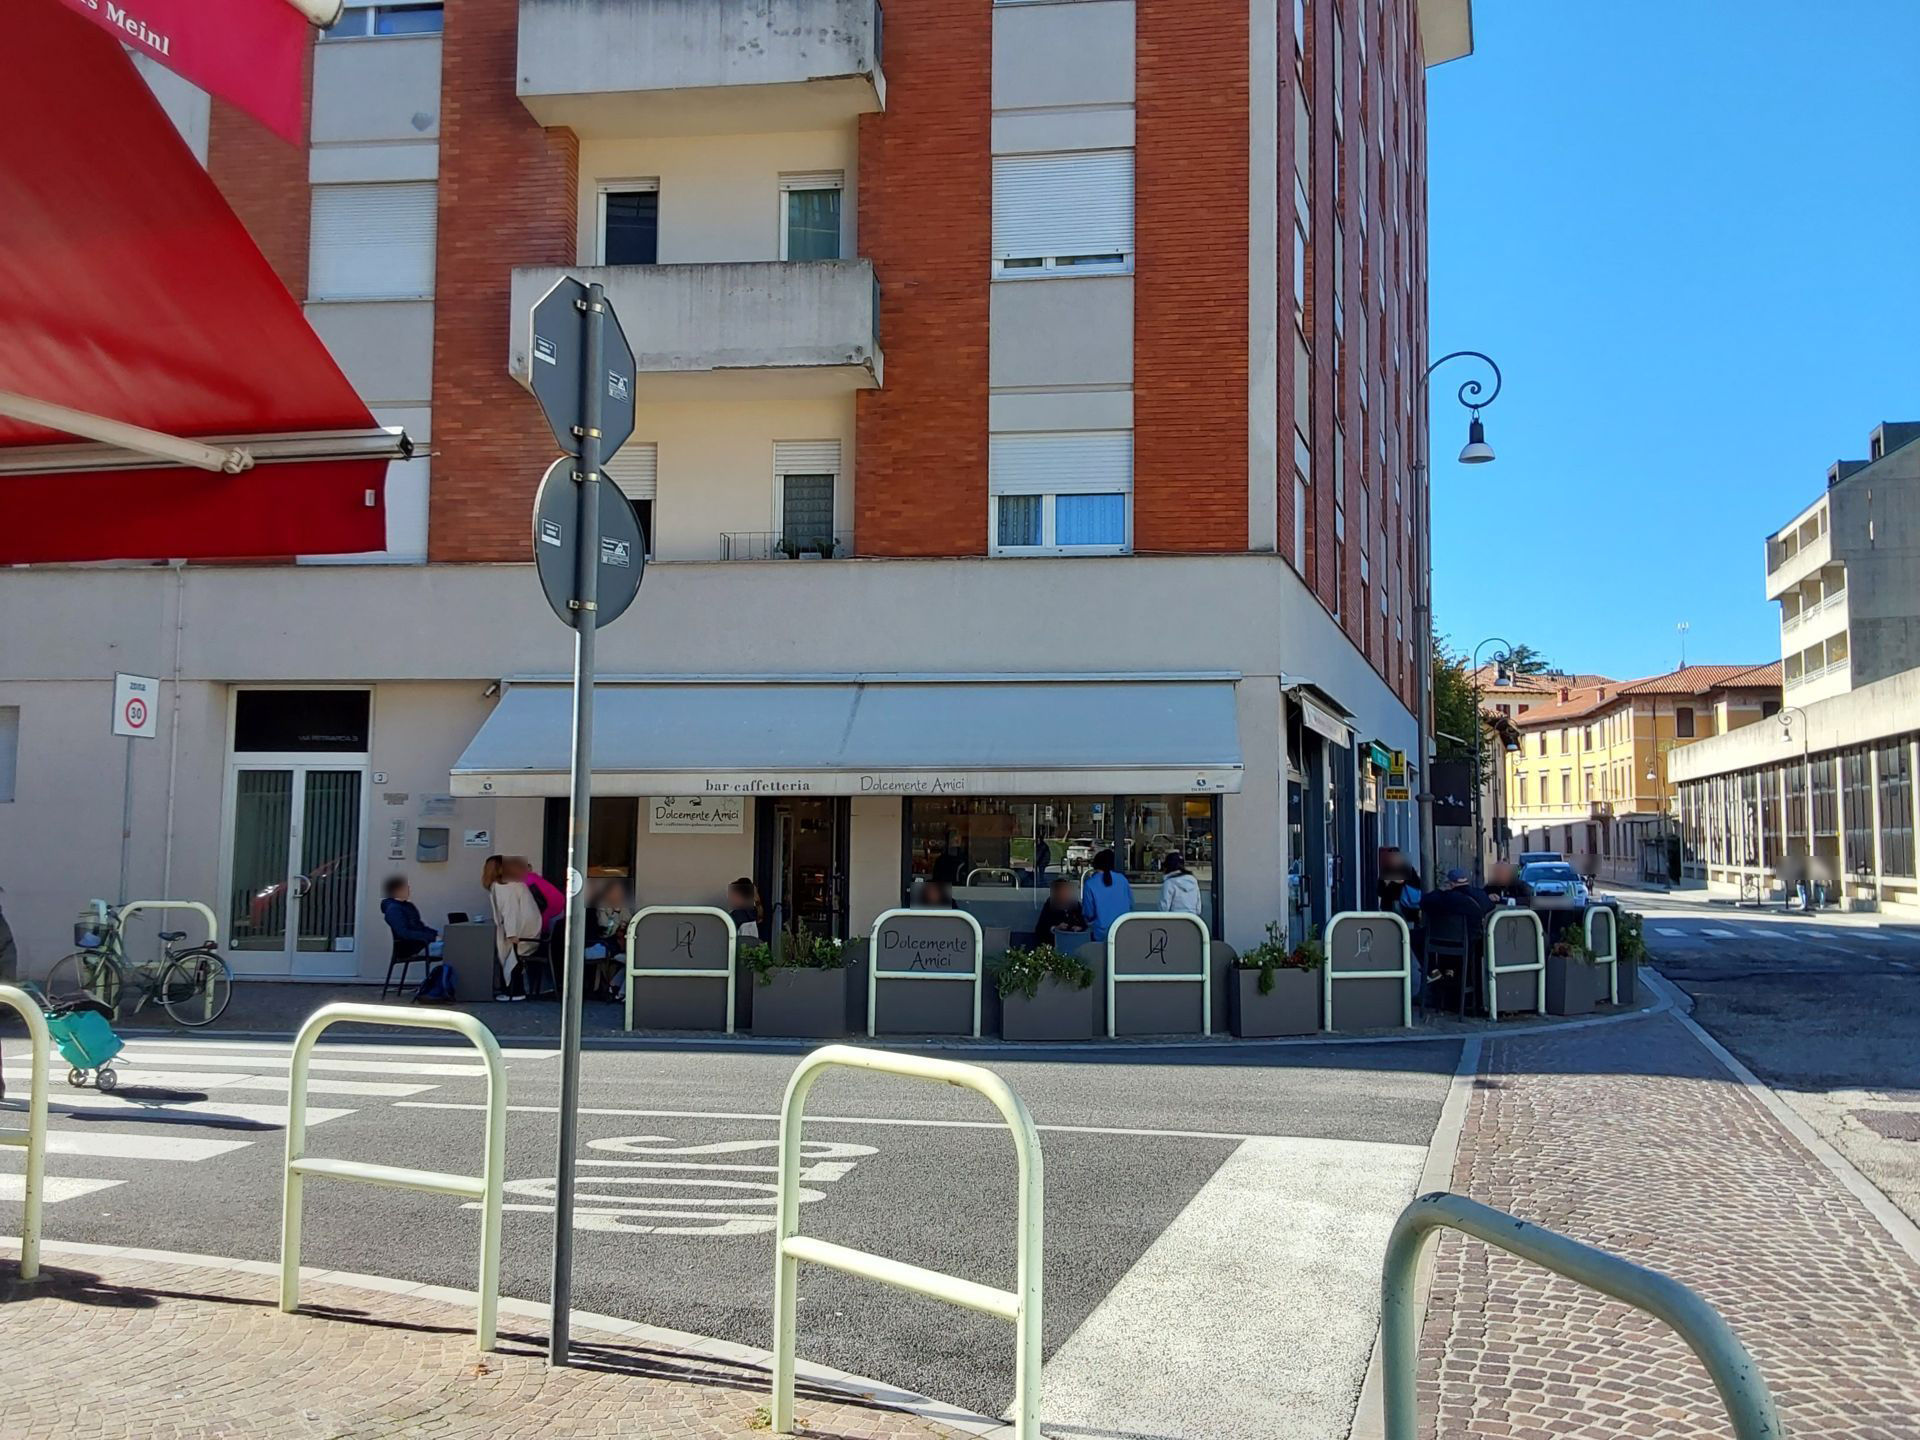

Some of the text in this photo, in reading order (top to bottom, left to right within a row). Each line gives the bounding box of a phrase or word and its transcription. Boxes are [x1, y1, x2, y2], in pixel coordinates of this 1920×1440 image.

[106, 1, 170, 57] Meinl
[131, 707, 142, 719] 30
[860, 775, 965, 793] Dolcemente Amici
[655, 806, 739, 822] Dolcemente Amici
[883, 930, 968, 952] Dolcemente
[909, 951, 952, 970] Amici
